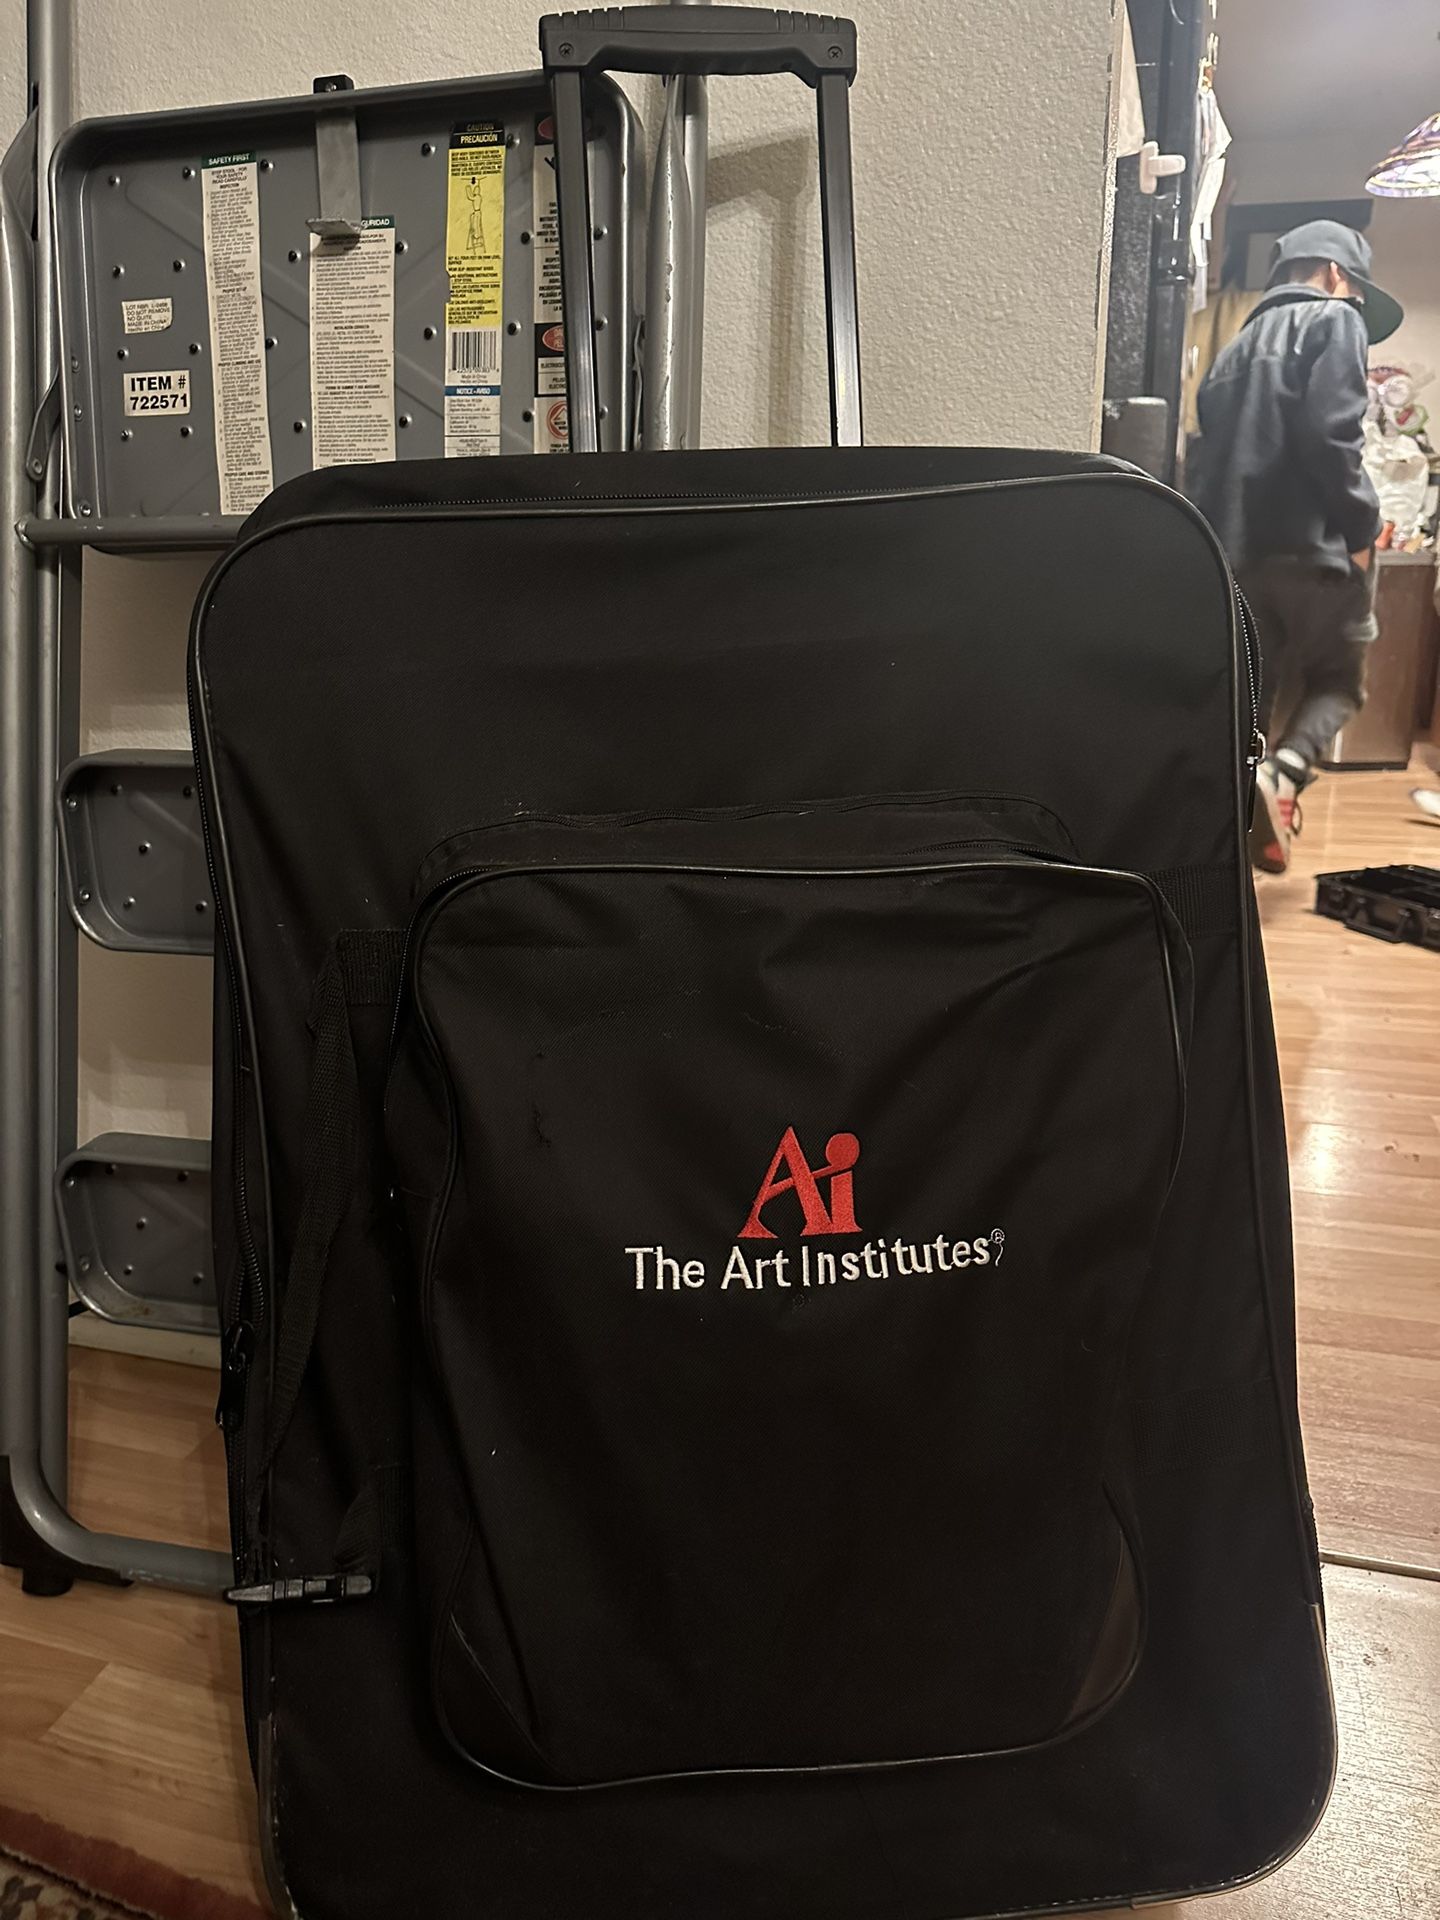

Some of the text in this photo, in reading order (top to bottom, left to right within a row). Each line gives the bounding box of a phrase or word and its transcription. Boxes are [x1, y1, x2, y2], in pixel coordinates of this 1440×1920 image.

[460, 132, 498, 144] PRECAUCIÓN
[208, 152, 250, 166] SAFETY FIRST
[360, 218, 390, 227] GURIDAD
[130, 374, 186, 392] ITEM #
[129, 393, 188, 411] 722571
[736, 1125, 864, 1239] Ai
[624, 1244, 706, 1290] The
[719, 1244, 793, 1290] Art
